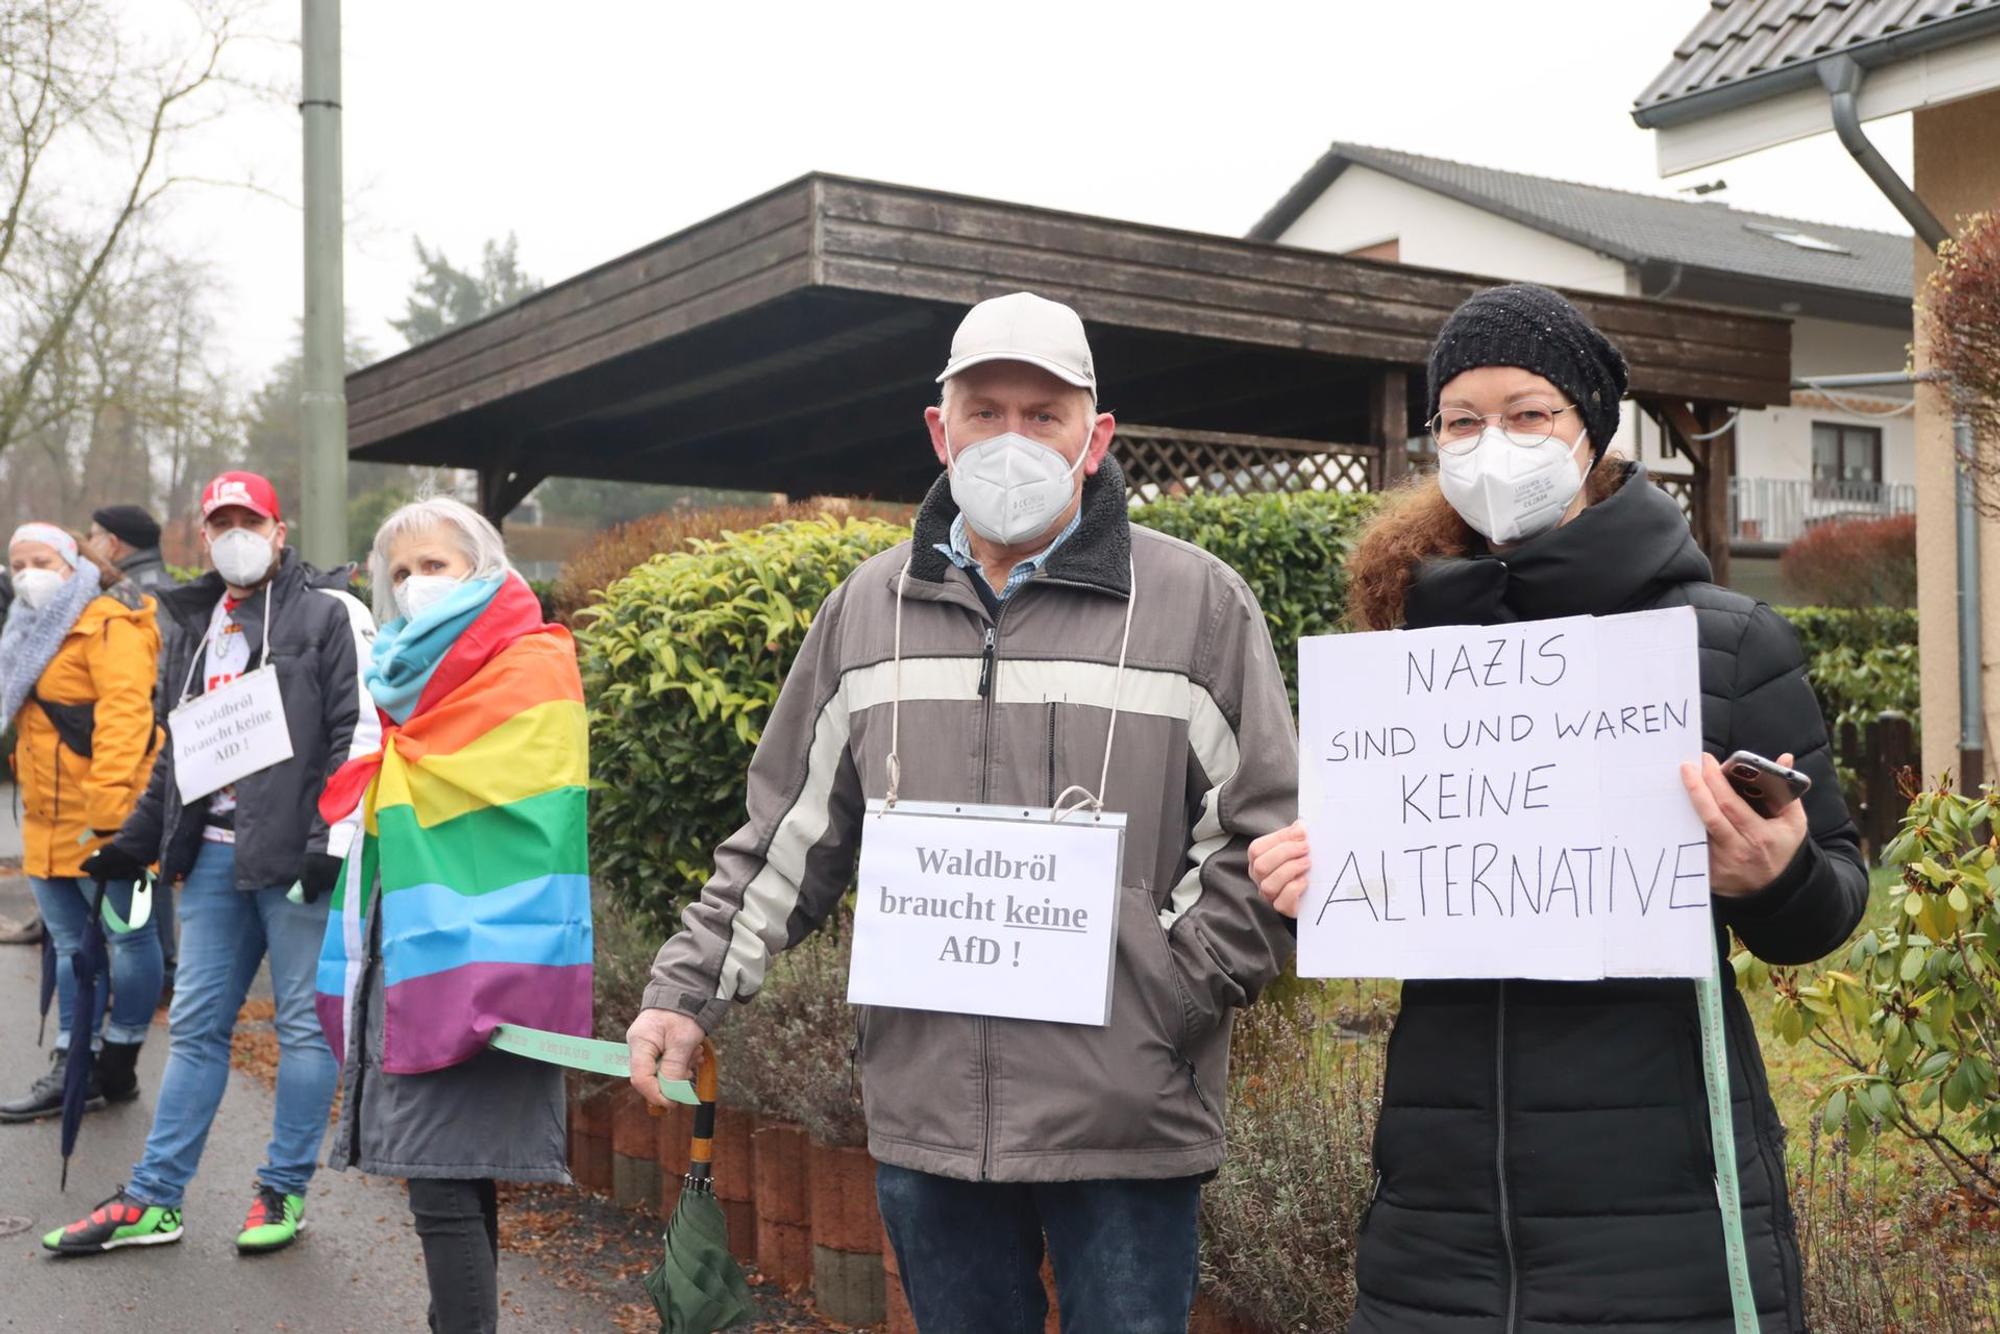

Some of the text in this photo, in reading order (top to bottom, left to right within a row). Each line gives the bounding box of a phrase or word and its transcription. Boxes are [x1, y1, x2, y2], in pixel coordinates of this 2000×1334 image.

[1406, 631, 1567, 695] NAZIS
[183, 709, 273, 758] braucht keine
[194, 693, 253, 731] Waldbröl
[1326, 698, 1688, 761] SIND UND WAREN
[215, 741, 240, 765] AfD
[1402, 763, 1556, 824] KEINE
[916, 846, 1057, 882] Waldbröl
[1316, 839, 1708, 926] ALTERNATIVE
[879, 886, 1088, 931] braucht keine
[938, 935, 1021, 968] AfD !
